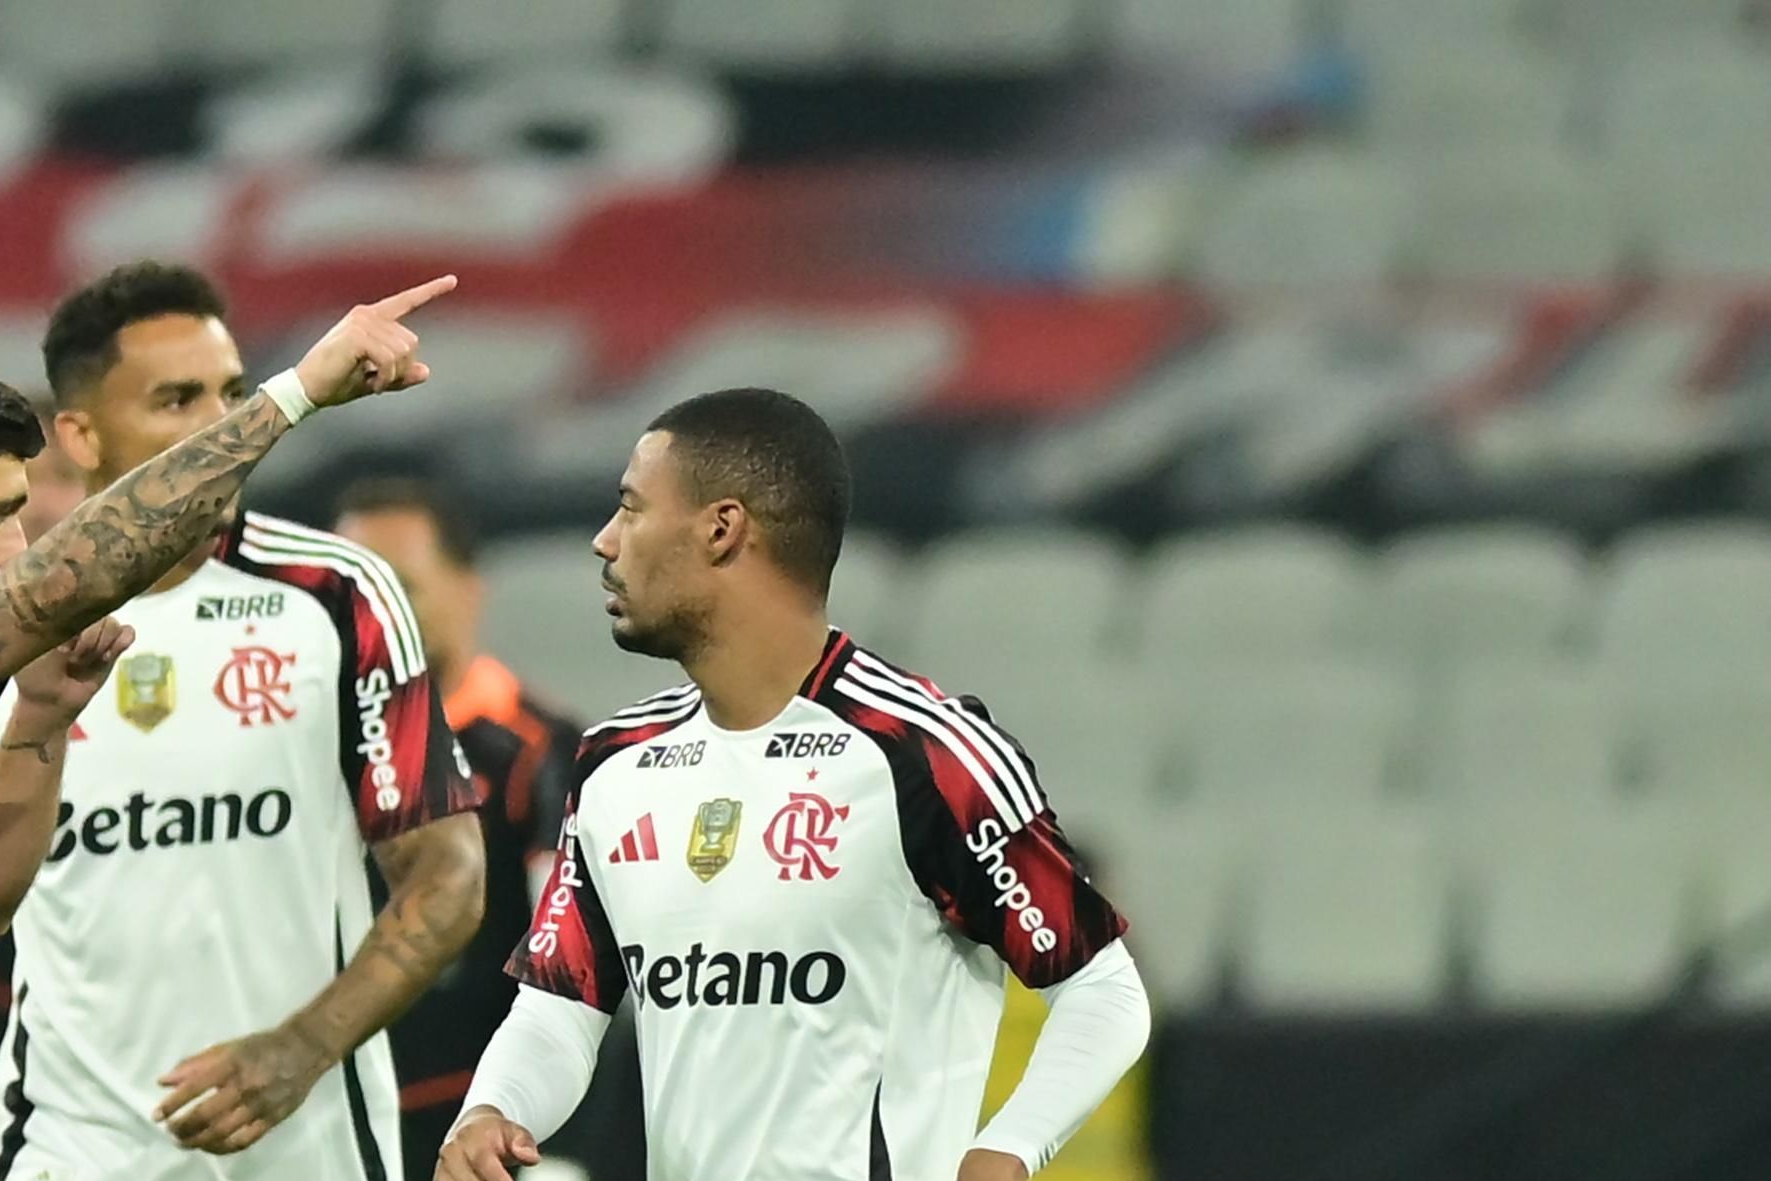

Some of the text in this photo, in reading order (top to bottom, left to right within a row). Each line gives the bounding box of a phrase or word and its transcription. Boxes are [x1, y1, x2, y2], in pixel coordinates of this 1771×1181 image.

[227, 594, 284, 619] BRB
[355, 668, 401, 812] Shopee
[663, 733, 851, 768] BRB BRB
[966, 818, 1056, 953] Shopee
